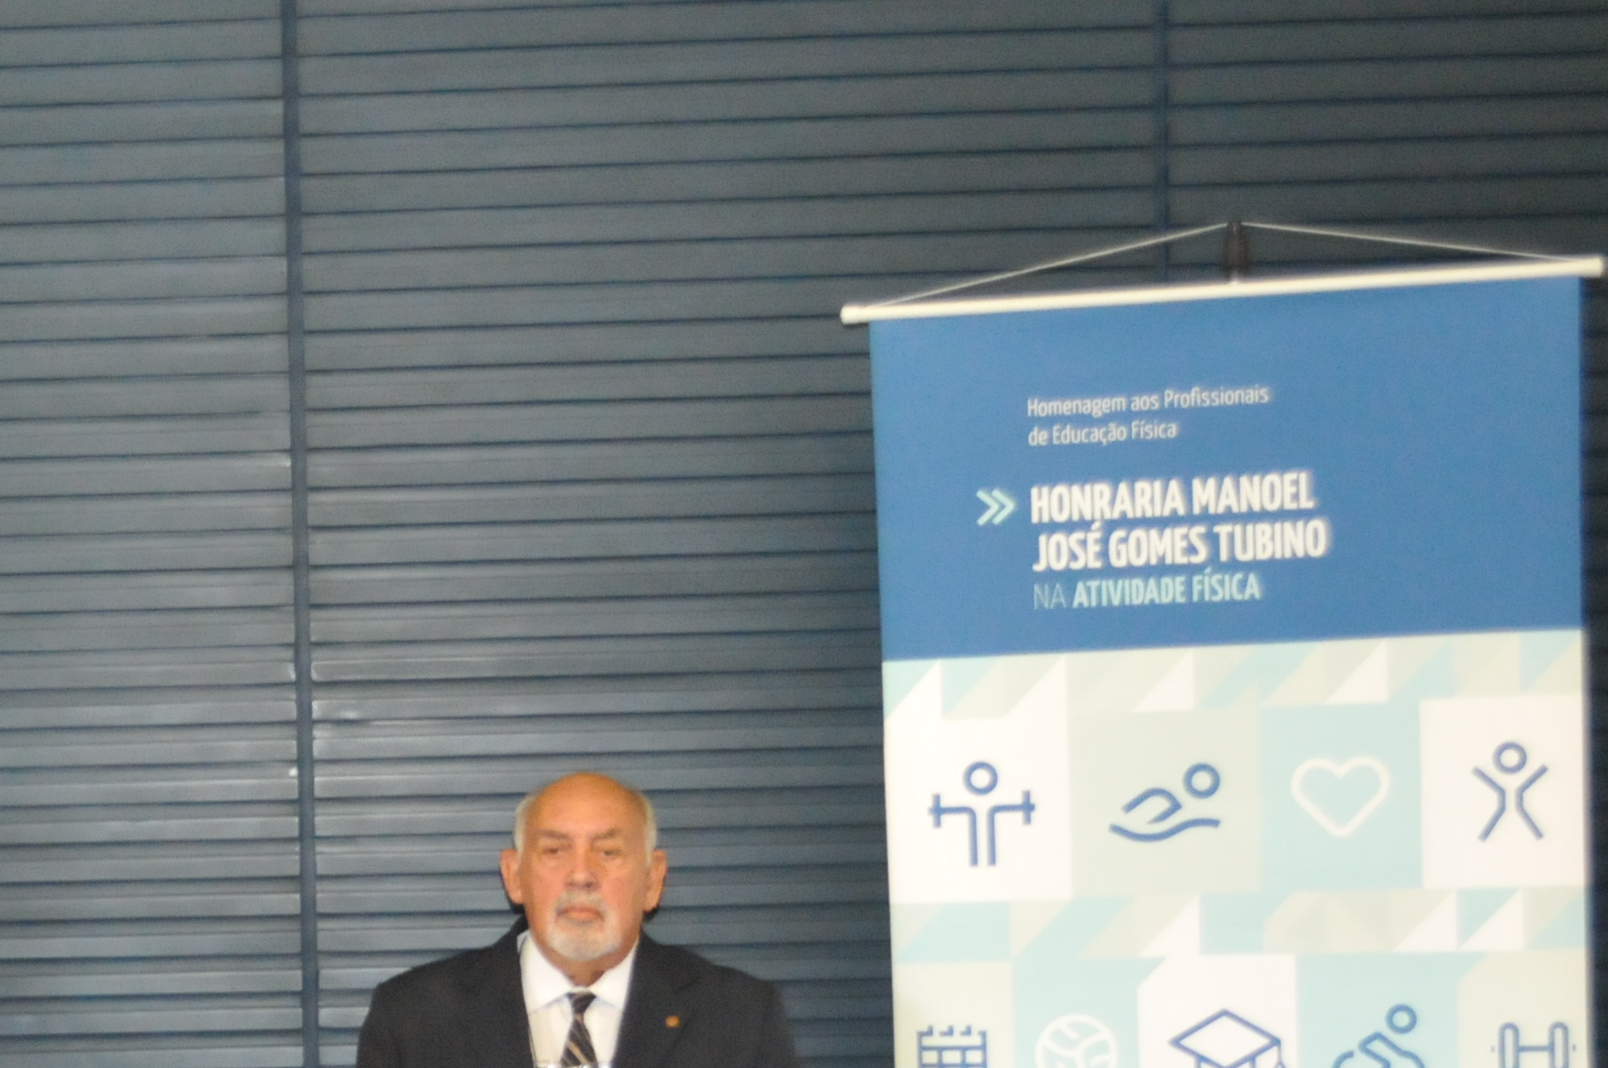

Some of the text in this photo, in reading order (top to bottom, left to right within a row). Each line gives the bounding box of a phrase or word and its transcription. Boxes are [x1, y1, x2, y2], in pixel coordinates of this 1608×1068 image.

[1027, 385, 1269, 418] Homenagem aos Profissionais
[1028, 421, 1177, 446] de Educação Física
[1030, 470, 1315, 524] HONRARIA MANOEL
[1032, 518, 1328, 572] JOSÉ GOMES TUBINO
[1033, 567, 1261, 609] NA ATIVIDADE FÍSICA
